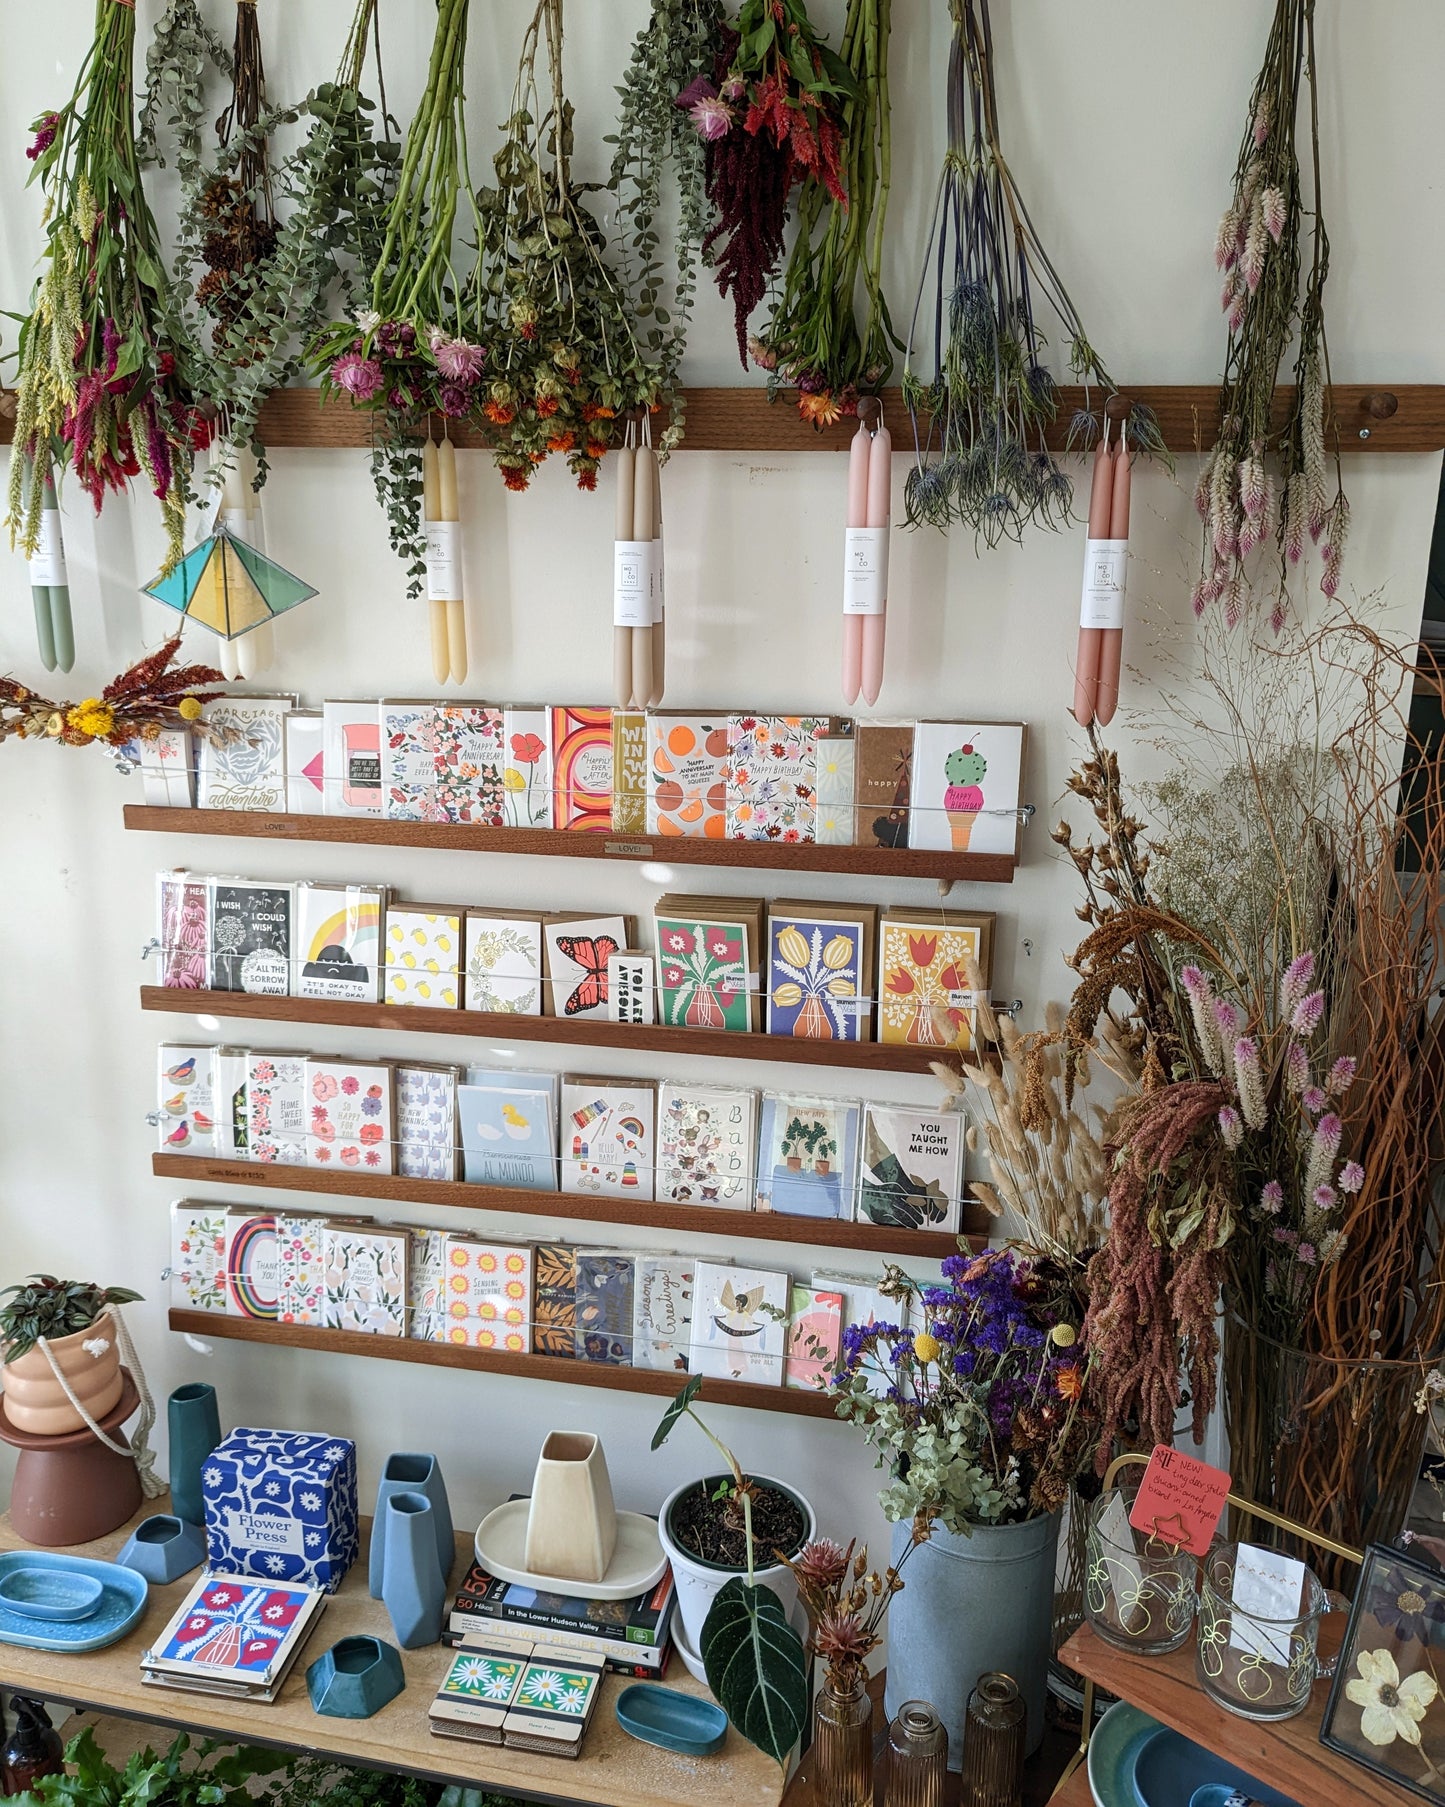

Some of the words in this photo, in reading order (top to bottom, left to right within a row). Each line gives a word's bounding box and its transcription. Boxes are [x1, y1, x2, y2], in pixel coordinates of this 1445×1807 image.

[210, 707, 282, 726] MARRIAGE
[468, 739, 493, 751] HAPPY
[624, 743, 643, 757] IN
[582, 752, 613, 764] HAPPILY
[679, 764, 714, 775] ANNIVERSARY
[750, 763, 772, 775] HAPPY
[773, 765, 804, 777] BIRTHDAY
[583, 771, 612, 780] AFTER
[868, 779, 898, 788] happy
[208, 784, 283, 812] adventure
[947, 788, 972, 801] HAPPY
[950, 800, 982, 811] BIRTHDAY
[618, 844, 641, 853] LOVE!
[221, 900, 241, 910] WISH
[257, 912, 286, 922] COULD
[252, 923, 273, 932] WISH
[256, 965, 270, 973] ALL
[271, 966, 286, 974] THE
[250, 975, 286, 985] SORROW
[306, 980, 324, 988] IT'S
[632, 968, 643, 992] YOU
[262, 985, 285, 994] AWAY
[303, 987, 324, 995] FEEL
[280, 1099, 299, 1109] HOME
[343, 1101, 351, 1111] SO
[280, 1109, 302, 1119] SWEET
[337, 1111, 361, 1121] HAPPY
[284, 1118, 302, 1128] HOME
[341, 1121, 354, 1130] FOR
[920, 1123, 940, 1133] YOU
[911, 1133, 947, 1144] TAUGHT
[908, 1144, 922, 1153] ME
[925, 1146, 948, 1156] HOW
[484, 1160, 496, 1179] AL
[498, 1161, 535, 1183] MUNDO
[262, 1270, 276, 1280] YOU
[473, 1278, 498, 1288] SENDING
[474, 1287, 501, 1295] SUNSHINE
[651, 1268, 680, 1334] Greetings!
[1173, 1469, 1188, 1488] tiny
[1188, 1476, 1206, 1488] deer
[1148, 1484, 1171, 1501] brand
[1174, 1496, 1181, 1504] in
[1181, 1498, 1194, 1511] Los
[1194, 1504, 1217, 1524] Angeles
[239, 1514, 292, 1531] Flower
[245, 1528, 288, 1544] Press
[457, 1598, 473, 1610] 50
[474, 1602, 494, 1612] Hikes
[528, 1612, 549, 1622] Lower
[550, 1616, 578, 1627] Hudson
[578, 1622, 600, 1632] Valley
[499, 1625, 548, 1642] FLOWER
[551, 1635, 598, 1651] RECIPE
[602, 1643, 640, 1658] BOOK
